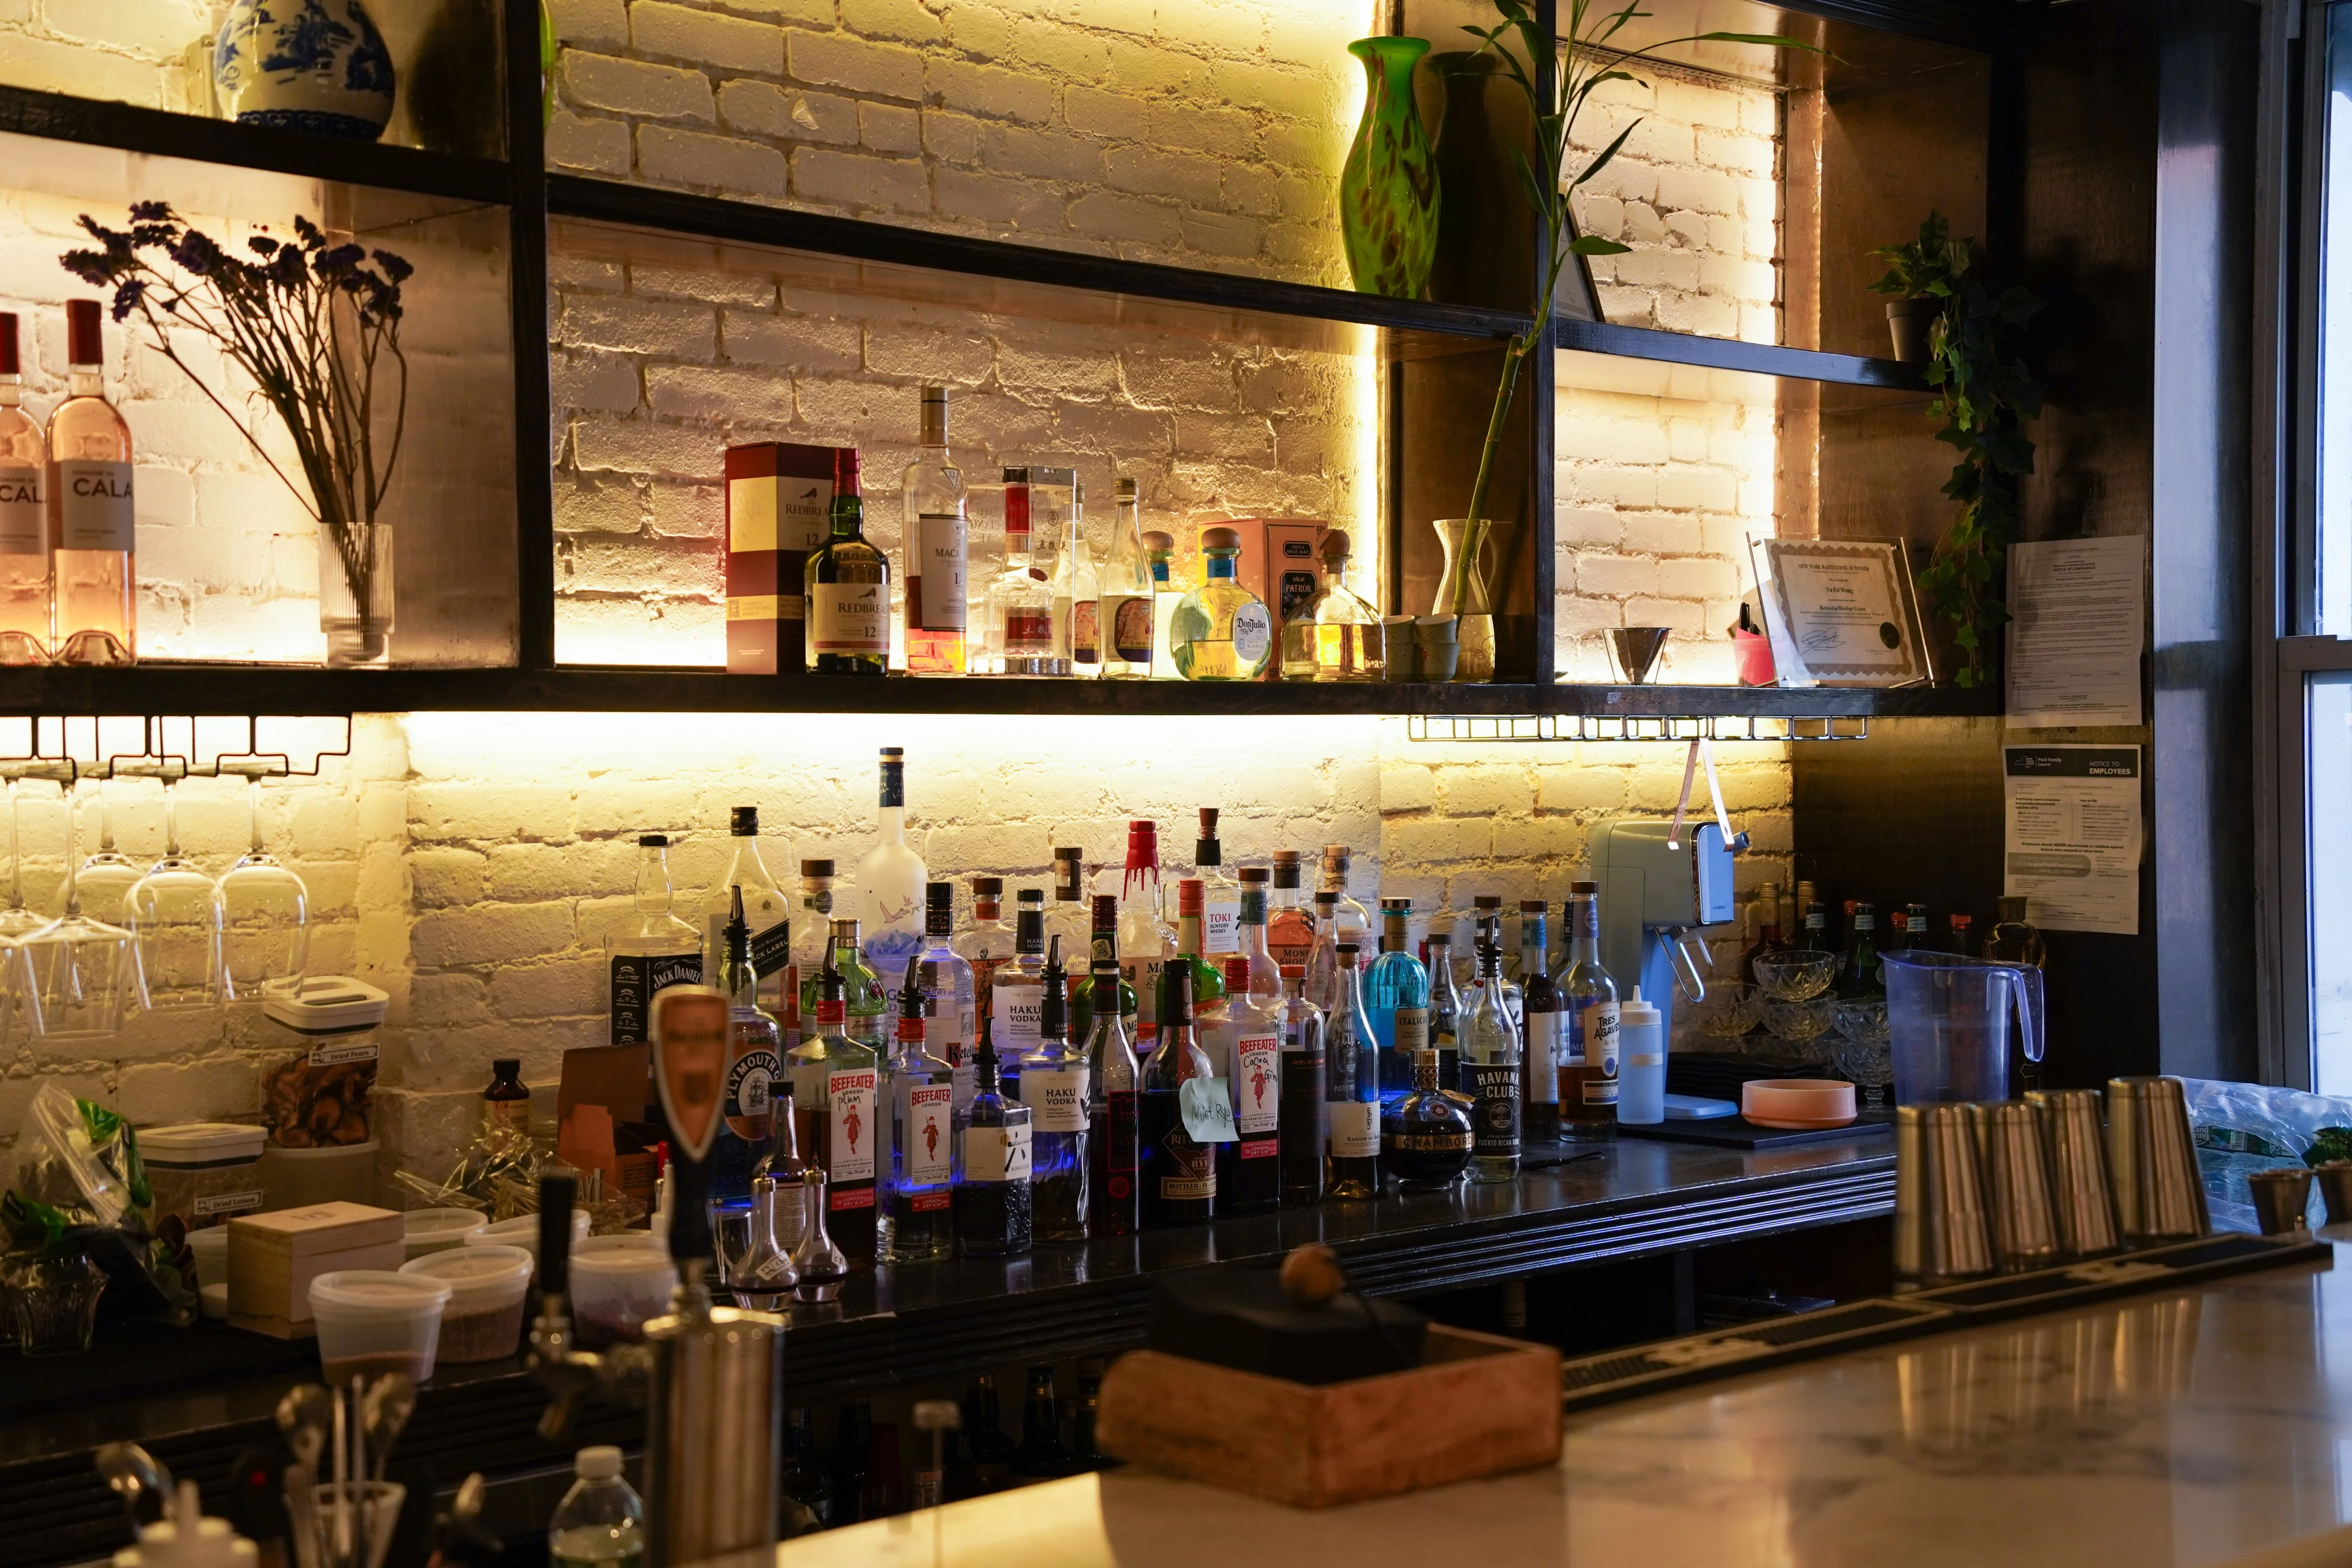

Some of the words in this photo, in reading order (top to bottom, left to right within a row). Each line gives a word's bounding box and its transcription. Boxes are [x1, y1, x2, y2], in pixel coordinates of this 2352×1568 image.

[0, 485, 46, 503] CAL
[73, 478, 133, 498] CALA
[786, 503, 829, 516] REDBREA
[805, 533, 819, 546] 12
[864, 626, 876, 638] 12
[1210, 913, 1230, 923] TOKI
[752, 952, 766, 962] ACK
[766, 939, 788, 954] LABEL
[653, 969, 673, 989] JACK
[1010, 1005, 1041, 1014] HAKU
[1598, 1015, 1616, 1031] TRES
[1239, 1038, 1277, 1056] BEEFEATER
[330, 1052, 349, 1061] Dried
[351, 1049, 370, 1059] Pears
[1243, 1056, 1269, 1068] Cocoa
[727, 1054, 777, 1099] PLYMOUTH
[1264, 1069, 1277, 1082] Gin
[1477, 1071, 1519, 1086] HAVANA
[831, 1074, 875, 1094] BEEFEATER
[912, 1089, 951, 1107] BEEFEATER
[1046, 1088, 1076, 1097] HAKU
[1486, 1086, 1514, 1098] CLUB
[838, 1093, 861, 1111] plum
[1191, 1103, 1214, 1123] Mint
[1403, 1136, 1473, 1148] CHAMBORD
[1498, 1138, 1511, 1146] RICAN
[1192, 1159, 1209, 1168] RYE
[213, 1199, 232, 1208] Dried
[233, 1196, 255, 1206] Lemon
